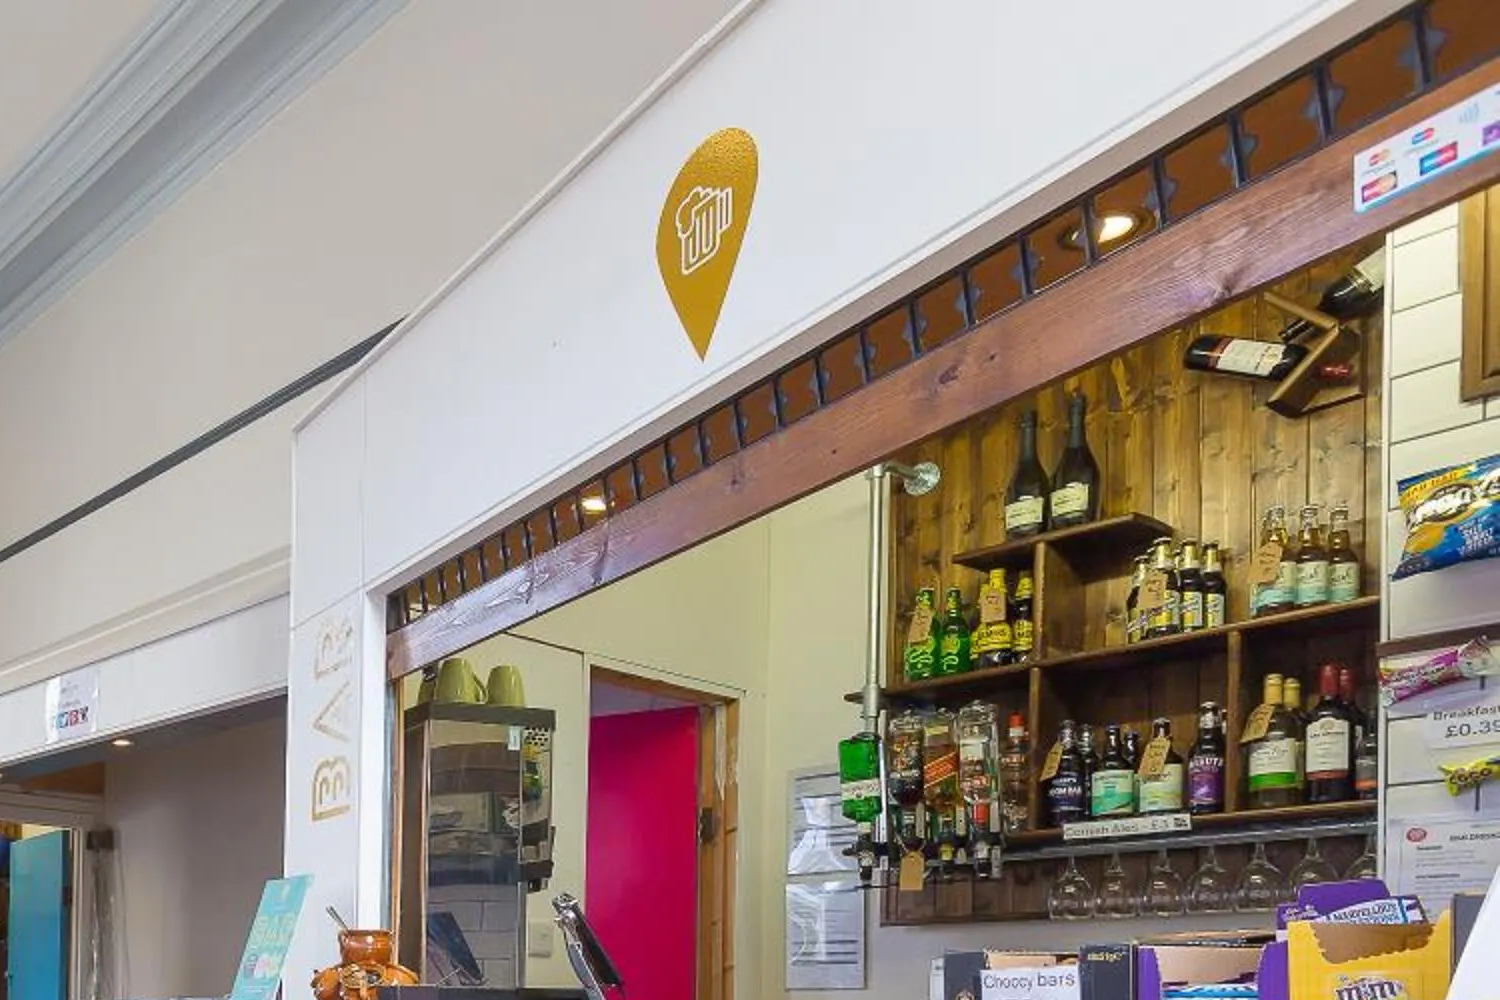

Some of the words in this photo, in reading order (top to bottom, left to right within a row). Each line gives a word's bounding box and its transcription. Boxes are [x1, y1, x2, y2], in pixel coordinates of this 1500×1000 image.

[312, 614, 354, 822] BAR
[983, 974, 1033, 992] Choccy
[1037, 972, 1075, 989] bars
